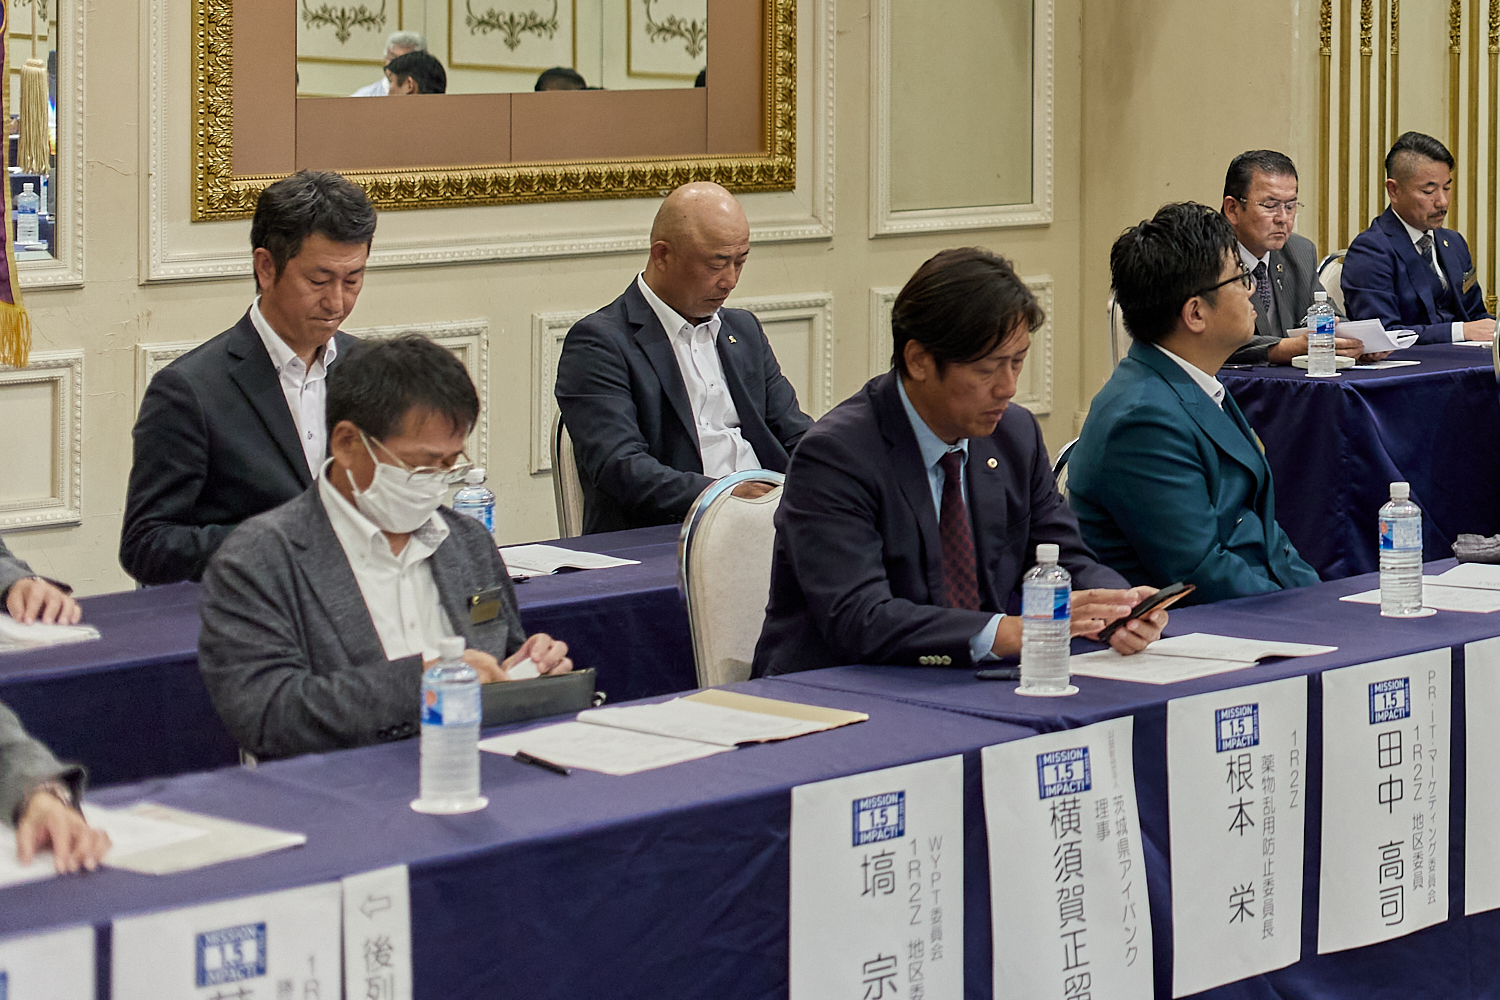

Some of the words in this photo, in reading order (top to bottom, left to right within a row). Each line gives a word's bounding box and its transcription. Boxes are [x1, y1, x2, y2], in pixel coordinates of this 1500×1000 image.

[1375, 678, 1404, 693] MISSION
[1383, 692, 1397, 709] 1.5
[1221, 704, 1253, 720] MISSION
[1230, 718, 1245, 736] 1.5
[1043, 748, 1083, 764] MISSION
[1054, 763, 1074, 781] 1.5
[1289, 729, 1299, 809] 1R2Z
[1378, 730, 1403, 814] 田中
[1413, 725, 1423, 801] 1R2Z
[859, 793, 898, 810] MISSION
[1226, 753, 1255, 837] 根本
[870, 808, 889, 827] 1.5
[861, 848, 897, 897] 塙
[1412, 812, 1424, 892] 地区委員
[908, 838, 922, 925] 1R2Z
[1378, 840, 1404, 927] 高司
[1229, 882, 1255, 924] 栄
